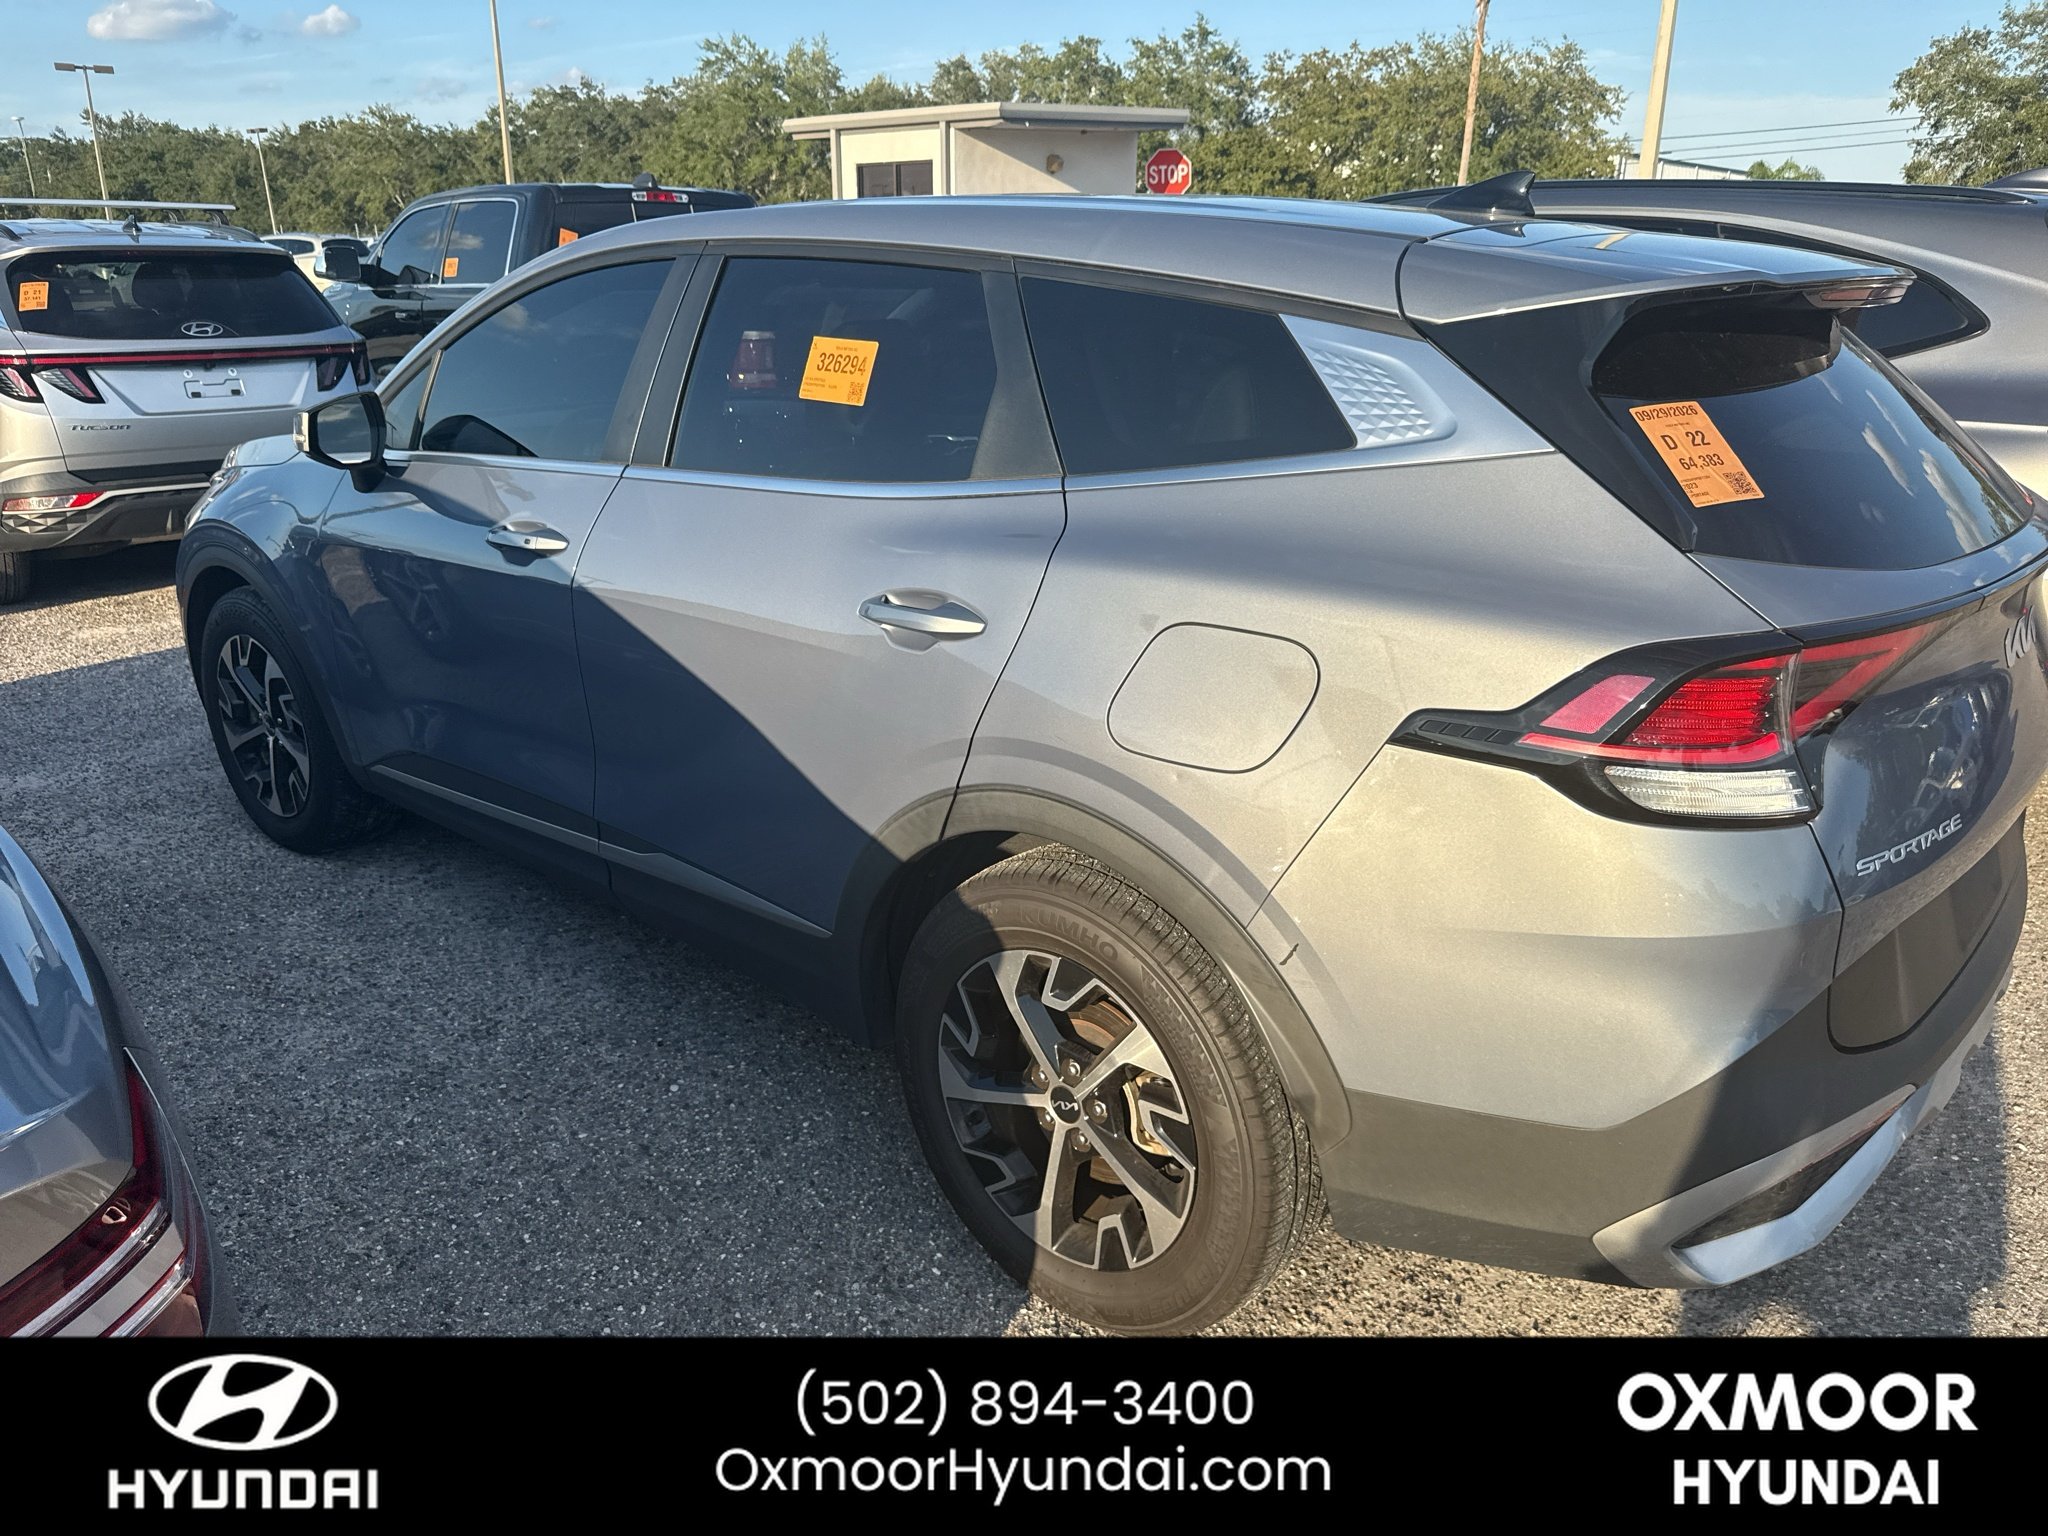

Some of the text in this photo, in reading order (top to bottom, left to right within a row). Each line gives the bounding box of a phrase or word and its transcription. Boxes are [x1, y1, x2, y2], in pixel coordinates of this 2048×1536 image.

[1149, 164, 1188, 184] STOP
[817, 352, 867, 376] 326294
[1635, 405, 1698, 422] 09/29/2026
[1660, 430, 1711, 450] D 22
[1679, 453, 1724, 470] 64,383
[1856, 814, 1962, 877] SPORTAGE
[1021, 908, 1118, 960] KUMHO
